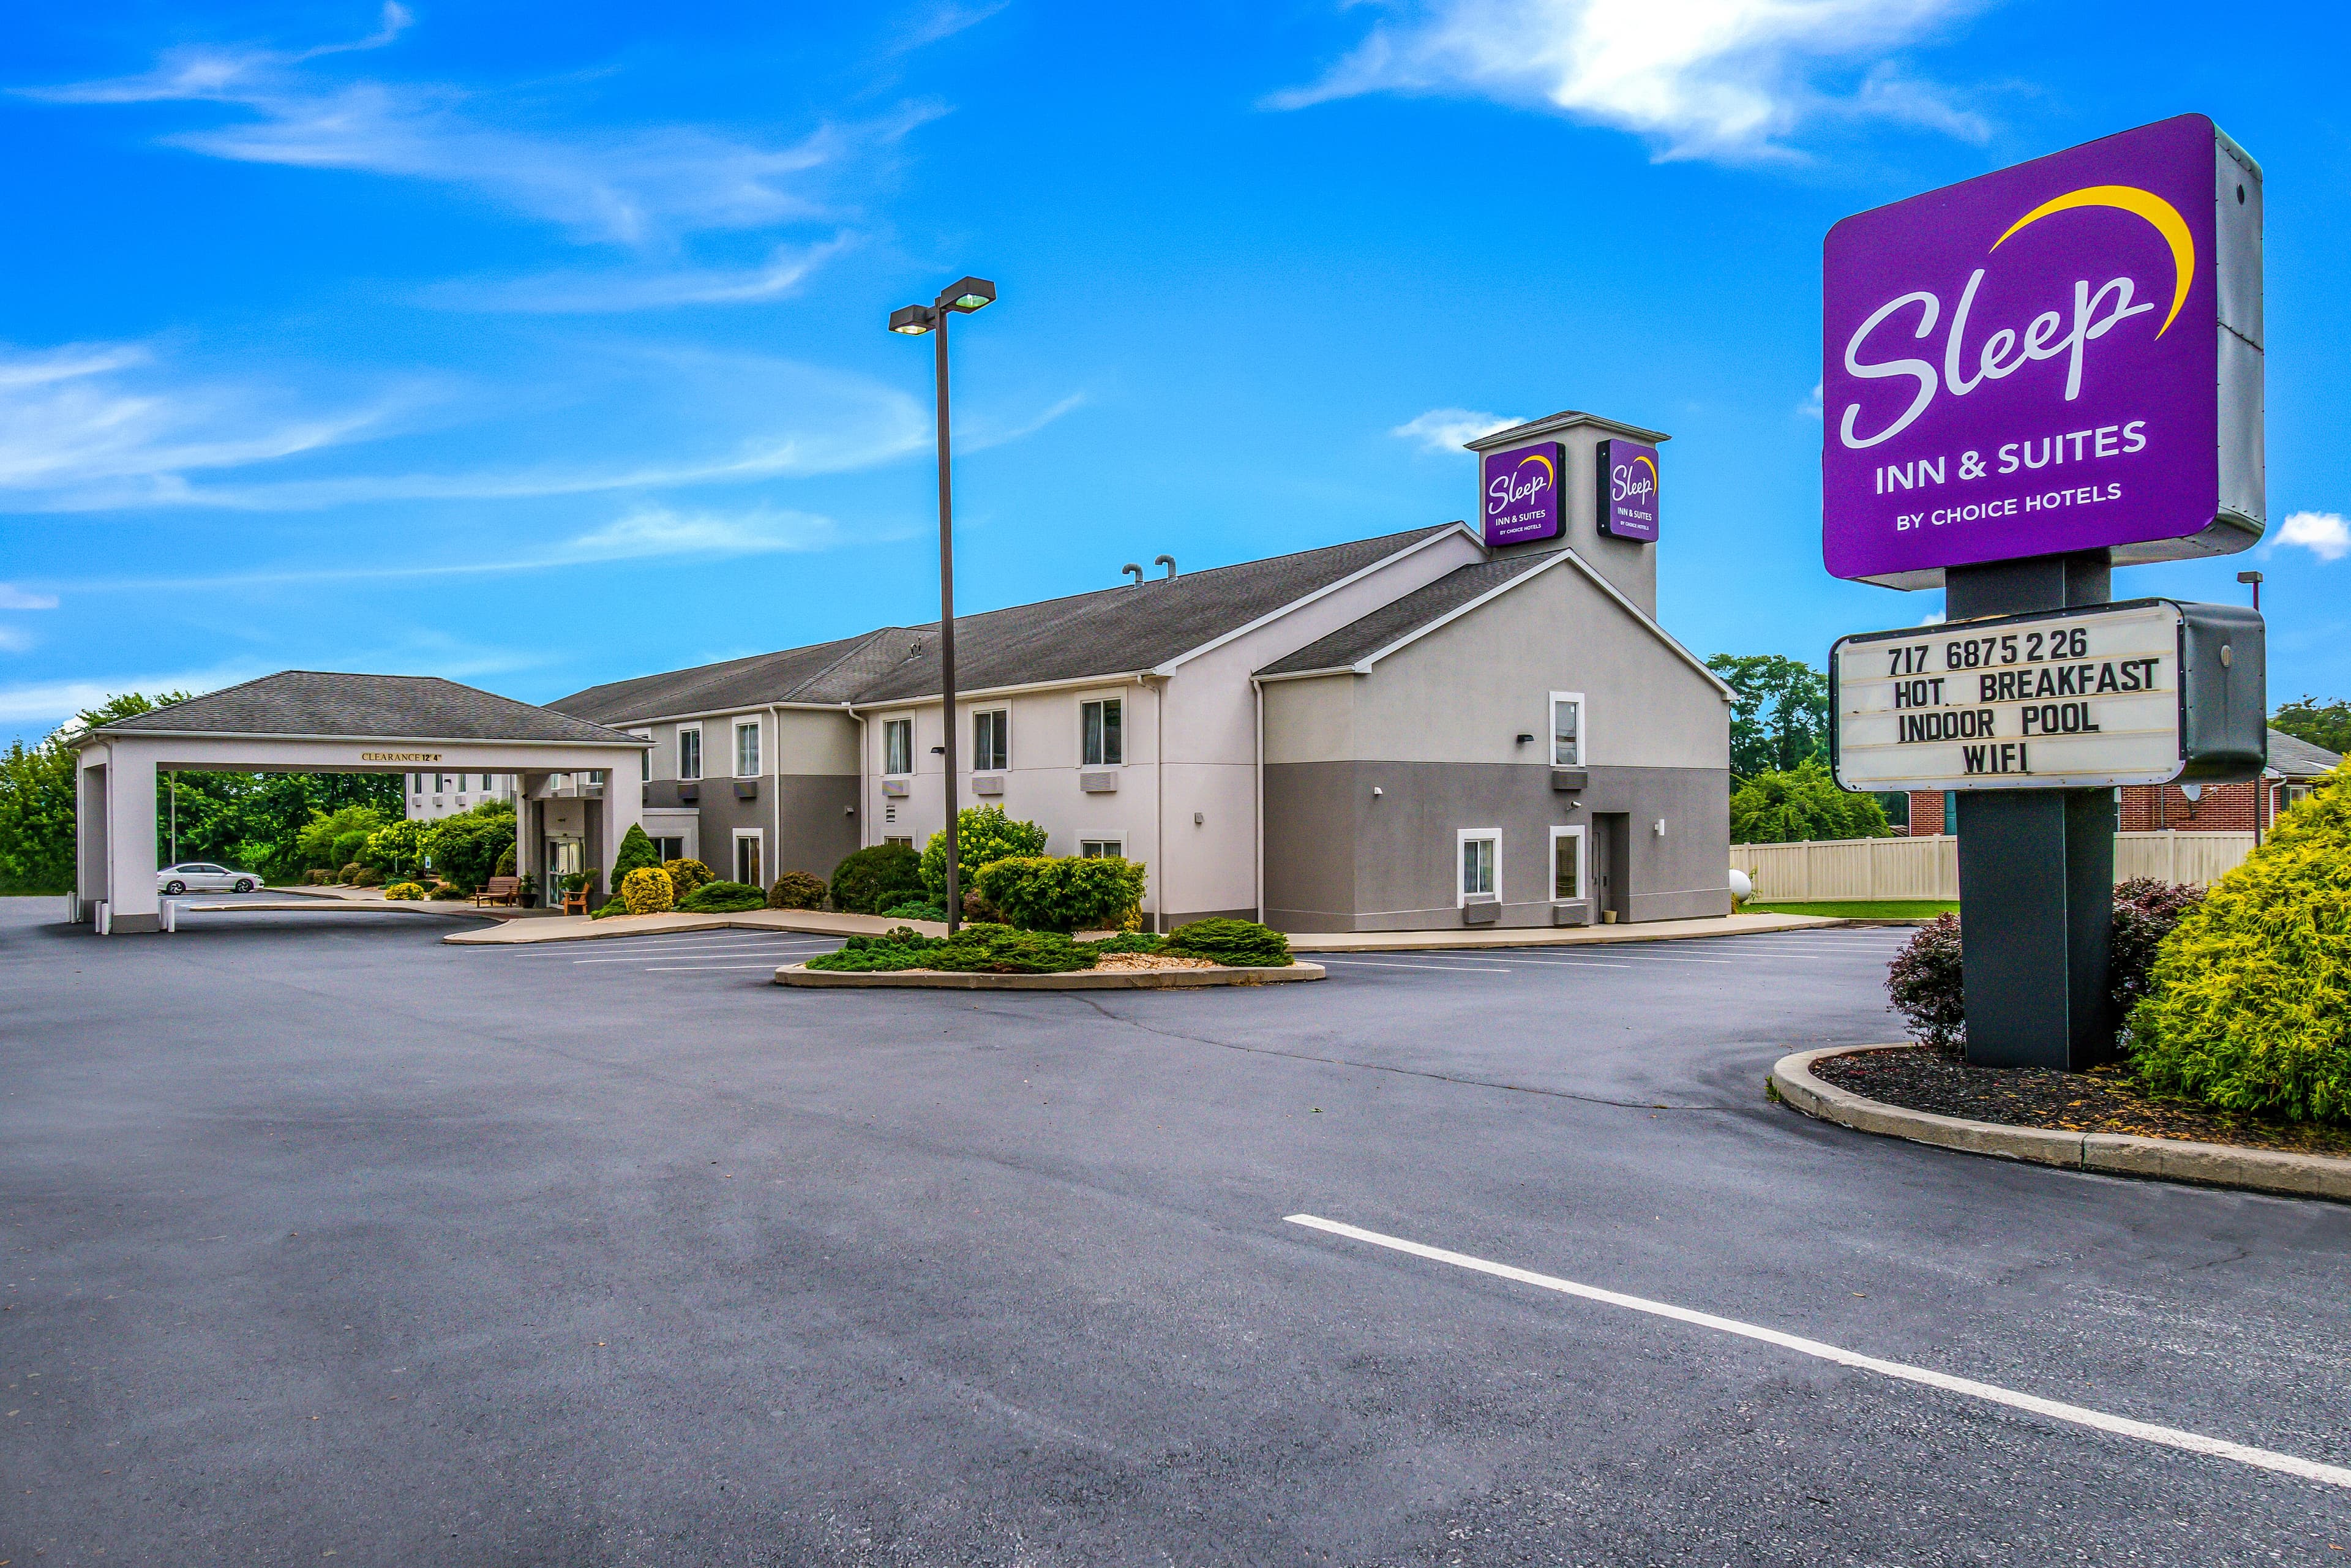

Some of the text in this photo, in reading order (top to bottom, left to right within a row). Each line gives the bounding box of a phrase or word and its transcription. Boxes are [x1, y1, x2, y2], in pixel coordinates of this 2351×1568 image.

[1840, 268, 2154, 449] Sleep
[1876, 421, 2147, 495] INN & SUITES
[1488, 471, 1547, 514] Sleep
[1612, 465, 1652, 505] Sleep
[1496, 517, 1510, 526] INN
[1519, 509, 1546, 520] SUITES
[1618, 507, 1628, 516] INN
[1634, 511, 1652, 521] SUITES
[1896, 482, 2122, 531] BY CHOICE HOTELS
[1888, 645, 1929, 675] 717
[1895, 658, 2159, 708] HOT BREAKFAST
[1899, 702, 2099, 742] INDOOR POOL
[1963, 743, 2028, 774] WIFI
